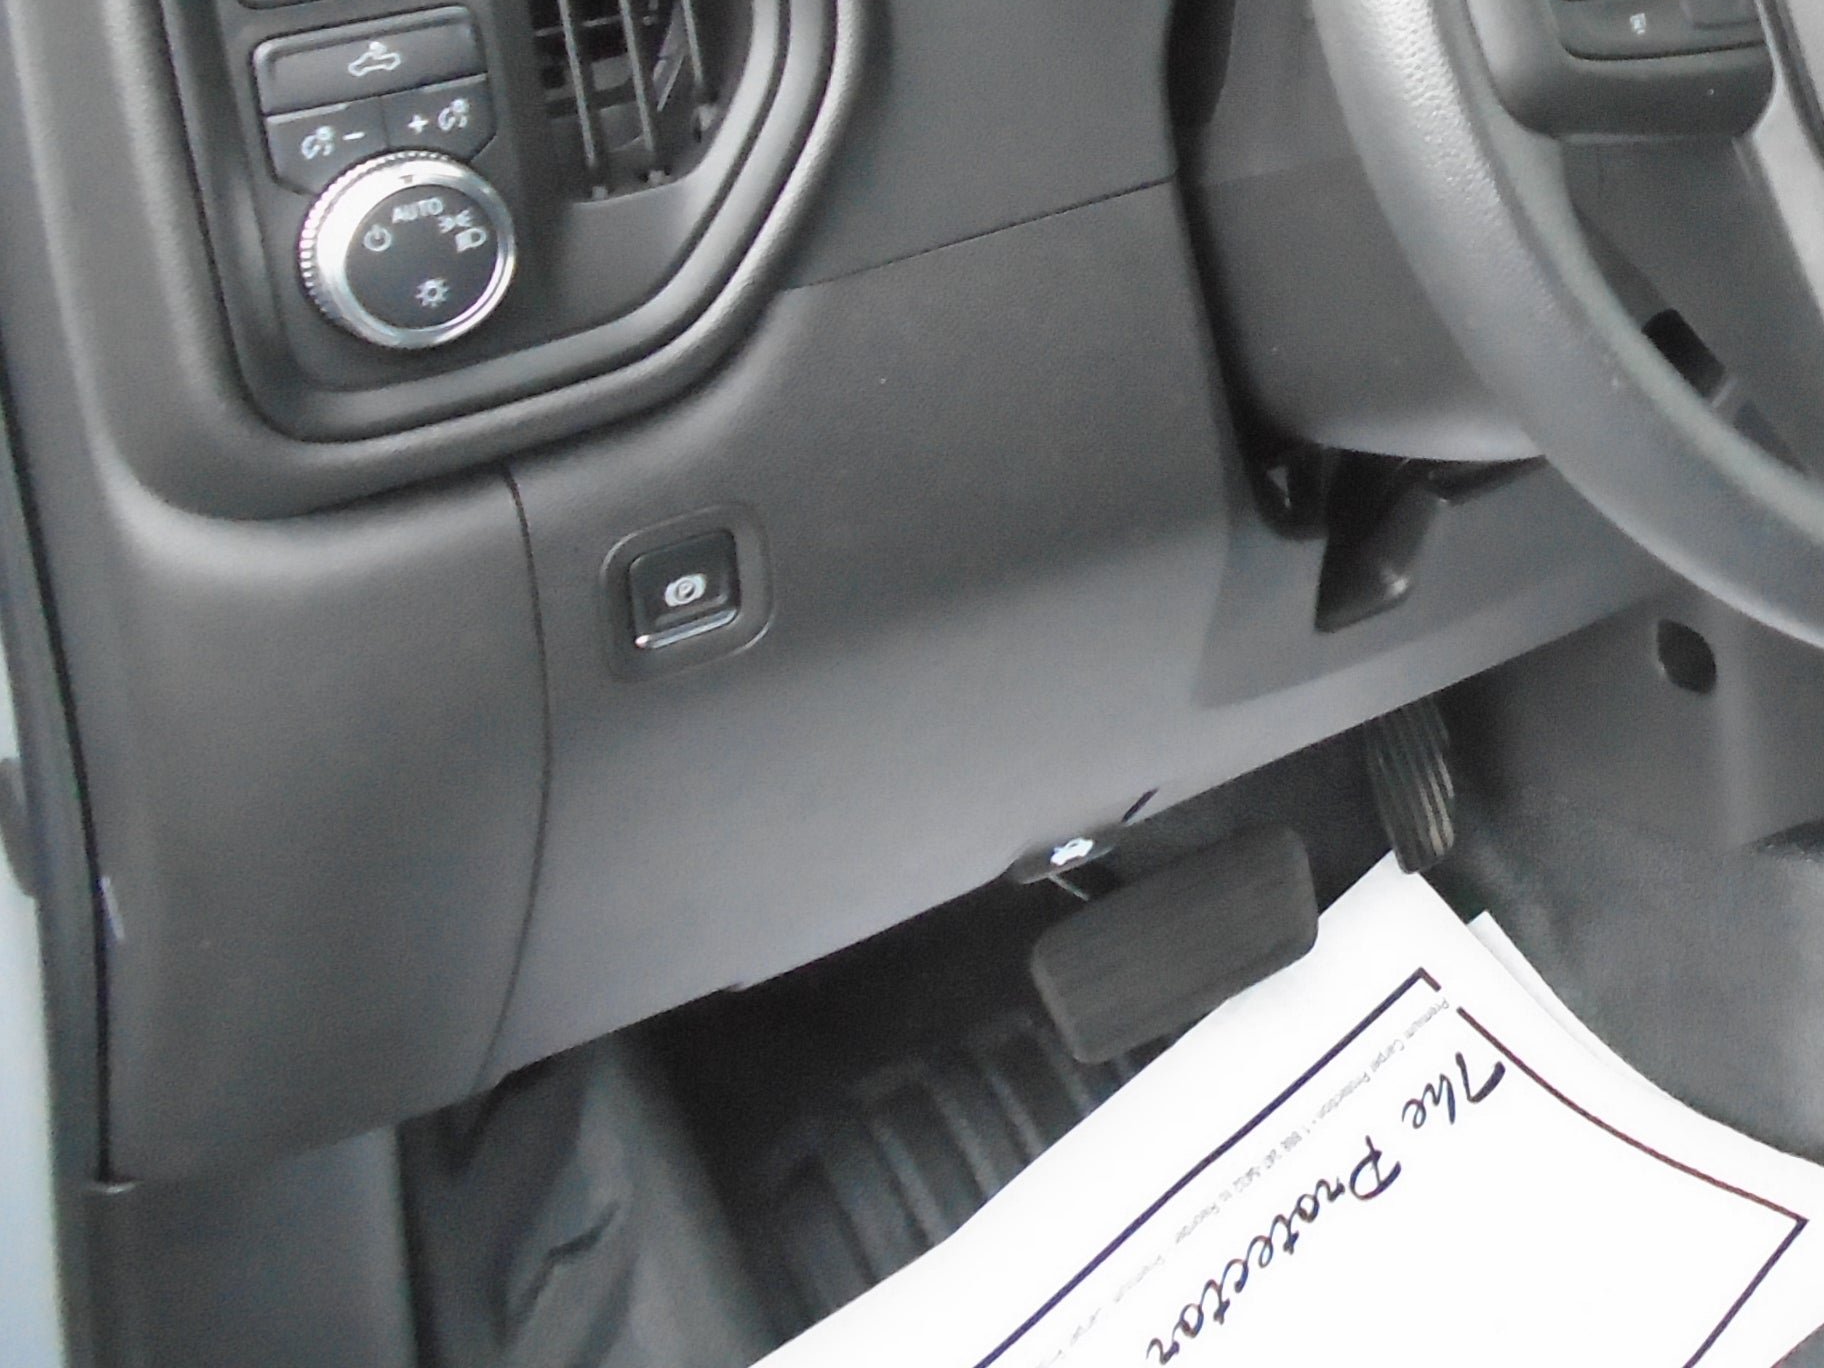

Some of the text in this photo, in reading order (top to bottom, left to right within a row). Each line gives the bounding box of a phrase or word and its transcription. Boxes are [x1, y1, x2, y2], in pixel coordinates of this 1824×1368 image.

[392, 197, 444, 224] AUTO
[1145, 1051, 1506, 1366] The Protector
